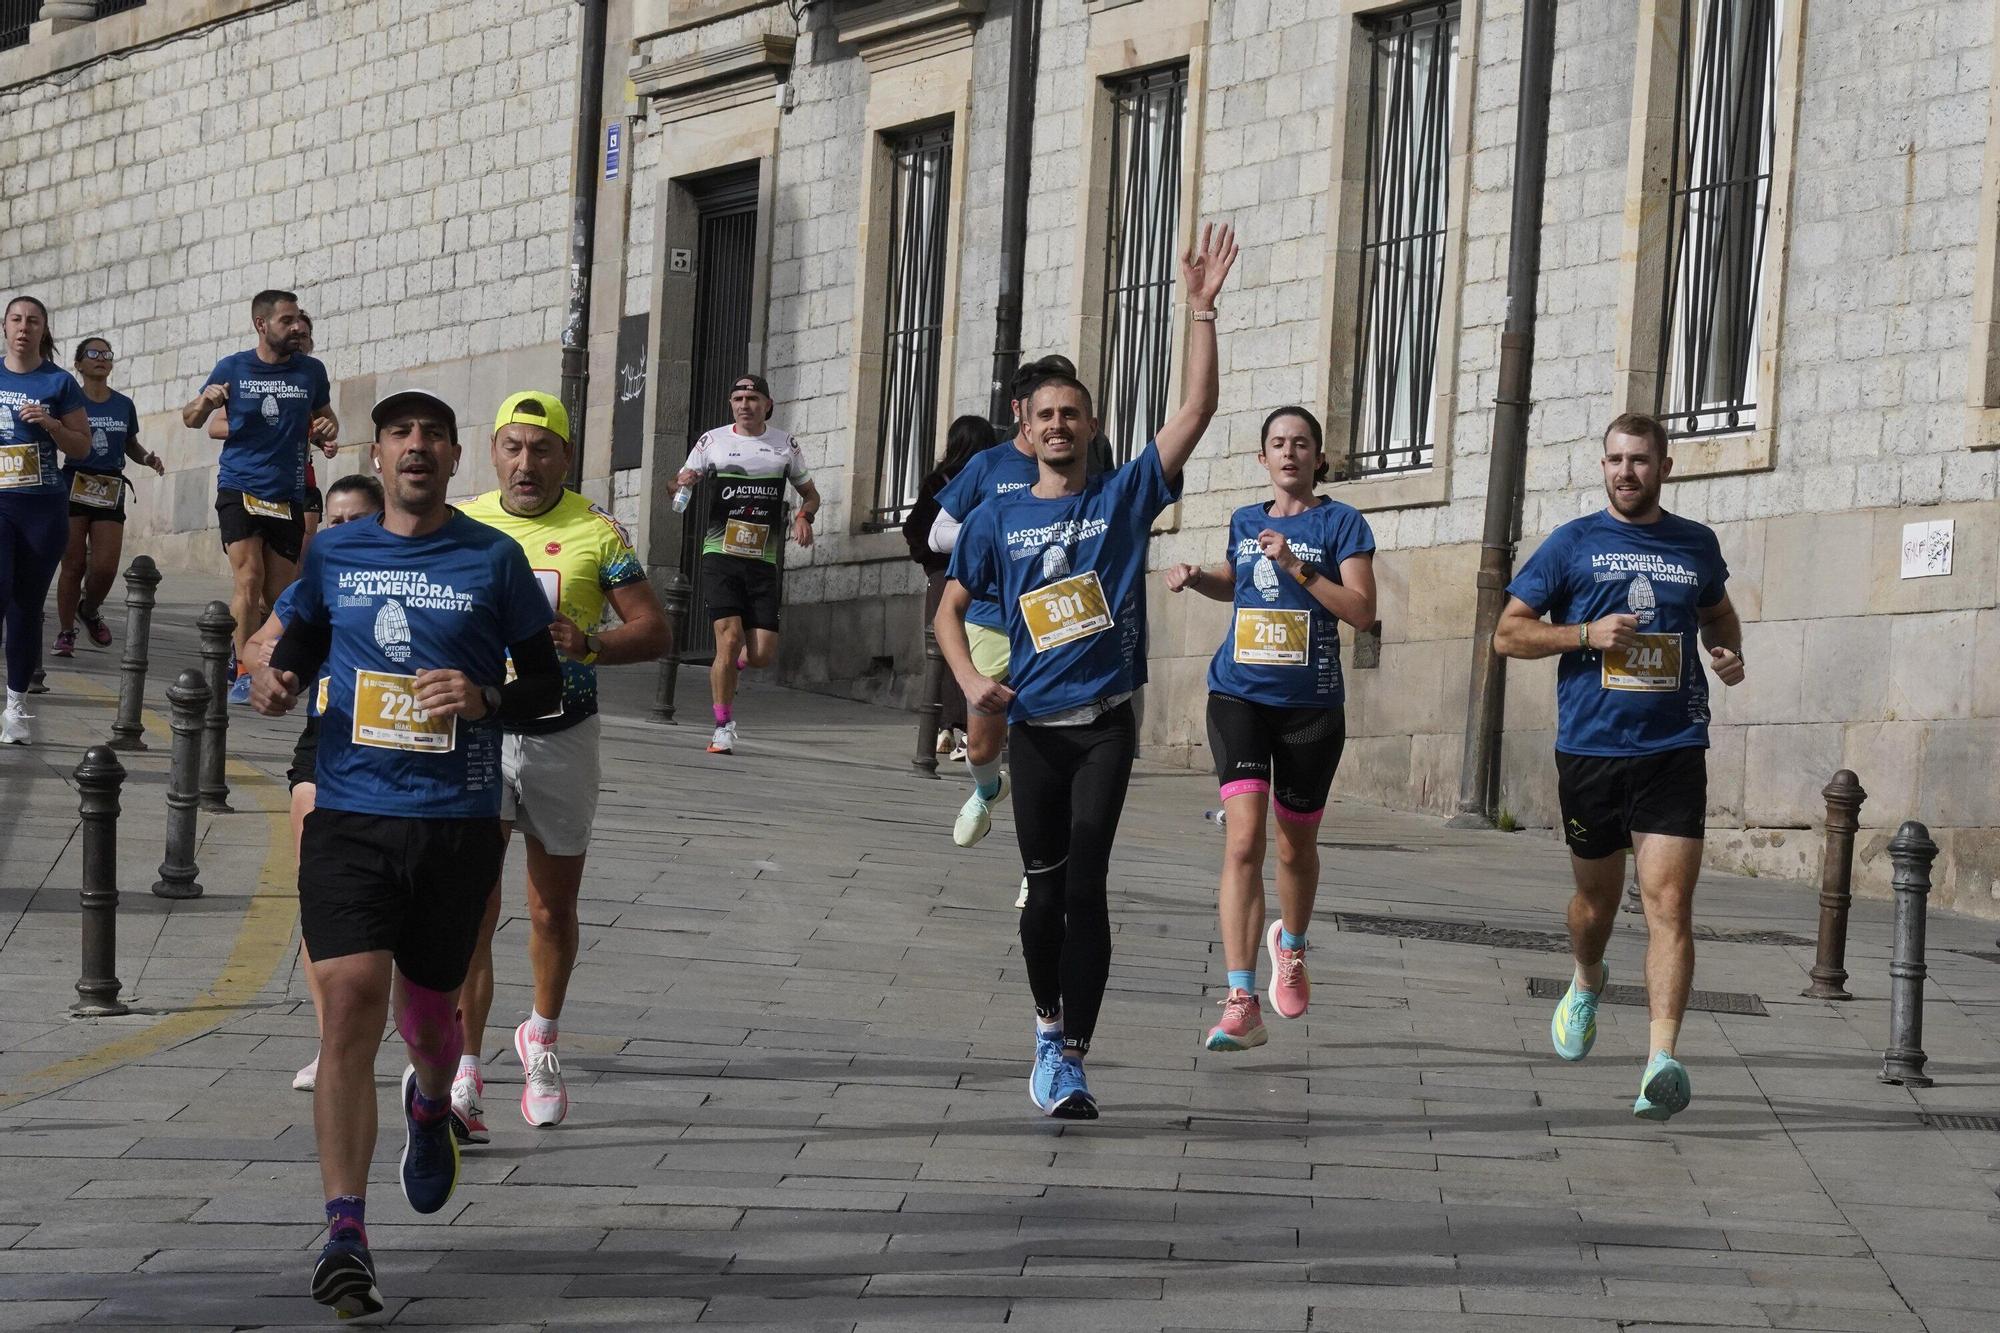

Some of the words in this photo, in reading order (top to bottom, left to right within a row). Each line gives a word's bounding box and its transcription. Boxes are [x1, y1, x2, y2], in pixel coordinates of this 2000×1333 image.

[675, 252, 686, 268] 5
[250, 385, 300, 393] ALMENDRA
[736, 486, 778, 496] ACTUALIZA
[1007, 531, 1020, 540] LA
[1020, 520, 1074, 538] CONQUISTA
[1023, 518, 1092, 548] ALMENDRA
[1063, 524, 1109, 547] KONKISTA
[1592, 554, 1605, 562] LA
[1605, 553, 1664, 563] CONQUISTA
[1609, 560, 1686, 575] ALMENDRA
[339, 572, 352, 582] LA
[353, 571, 428, 583] CONQUISTA
[1652, 573, 1699, 586] KONKISTA
[354, 581, 454, 599] ALMENDRA
[456, 592, 473, 601] REN
[405, 597, 474, 612] KONKISTA
[1045, 591, 1085, 623] 301
[1254, 622, 1287, 644] 215
[1625, 647, 1663, 670] 244
[380, 691, 429, 723] 225
